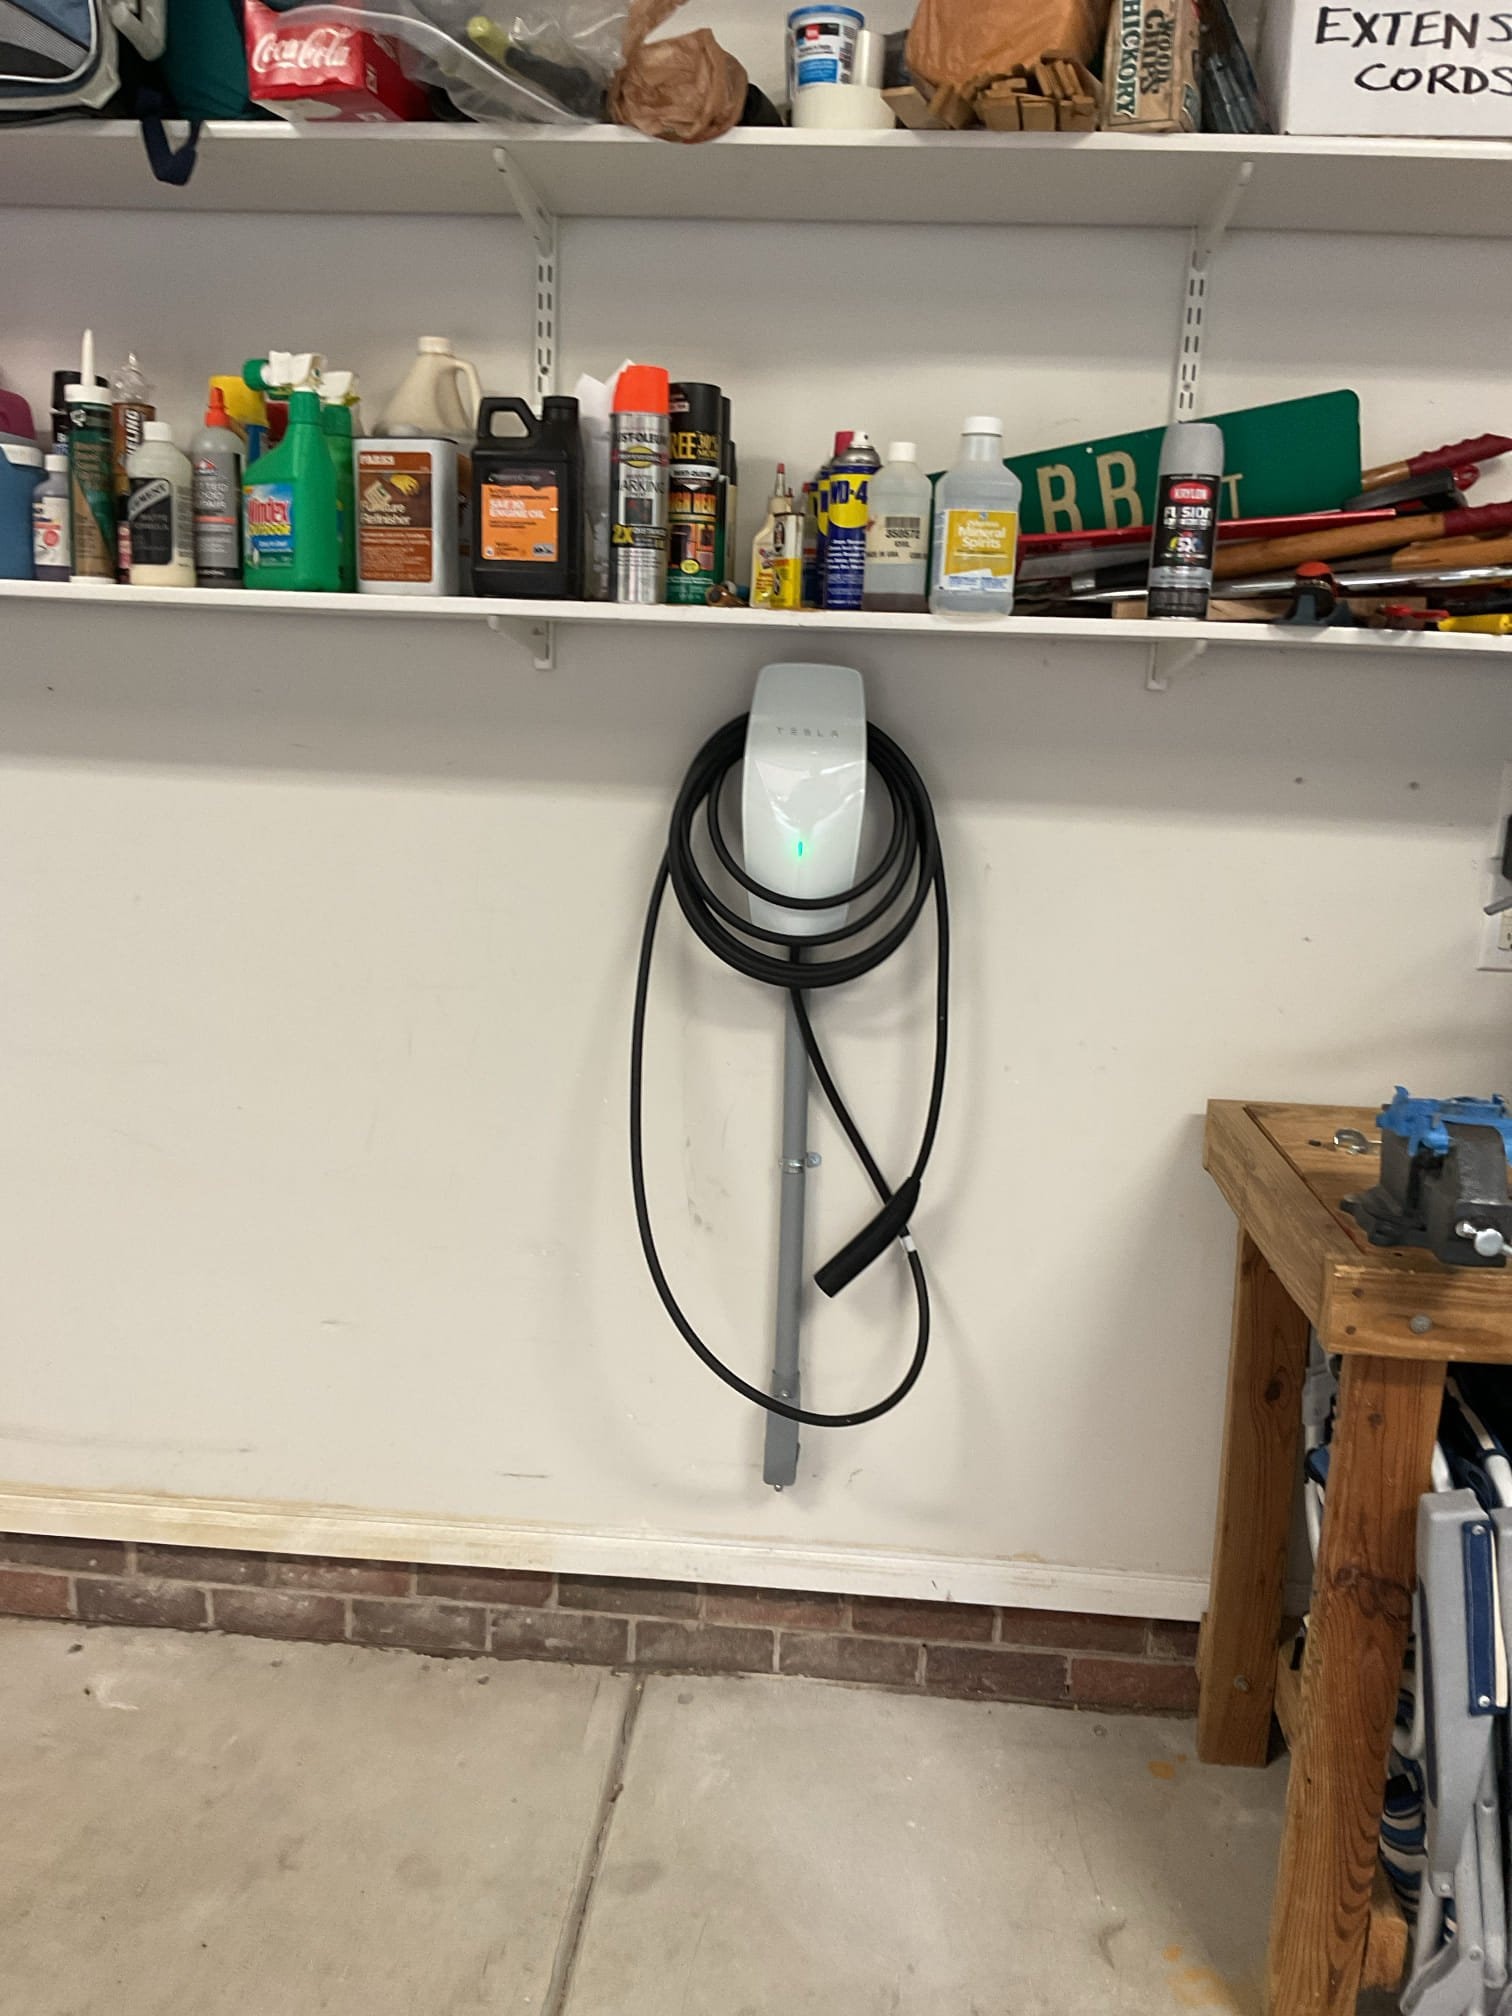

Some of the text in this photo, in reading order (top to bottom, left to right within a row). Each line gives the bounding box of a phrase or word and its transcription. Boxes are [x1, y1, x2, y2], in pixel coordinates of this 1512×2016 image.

[1315, 7, 1512, 49] EXTENS
[1117, 0, 1140, 114] HICKORY
[1354, 63, 1512, 96] CORDS
[670, 432, 697, 459] REE
[831, 480, 868, 504] WD-4
[958, 526, 1007, 539] Mineral
[961, 536, 1002, 549] Spirits
[775, 726, 839, 738] TESLA
